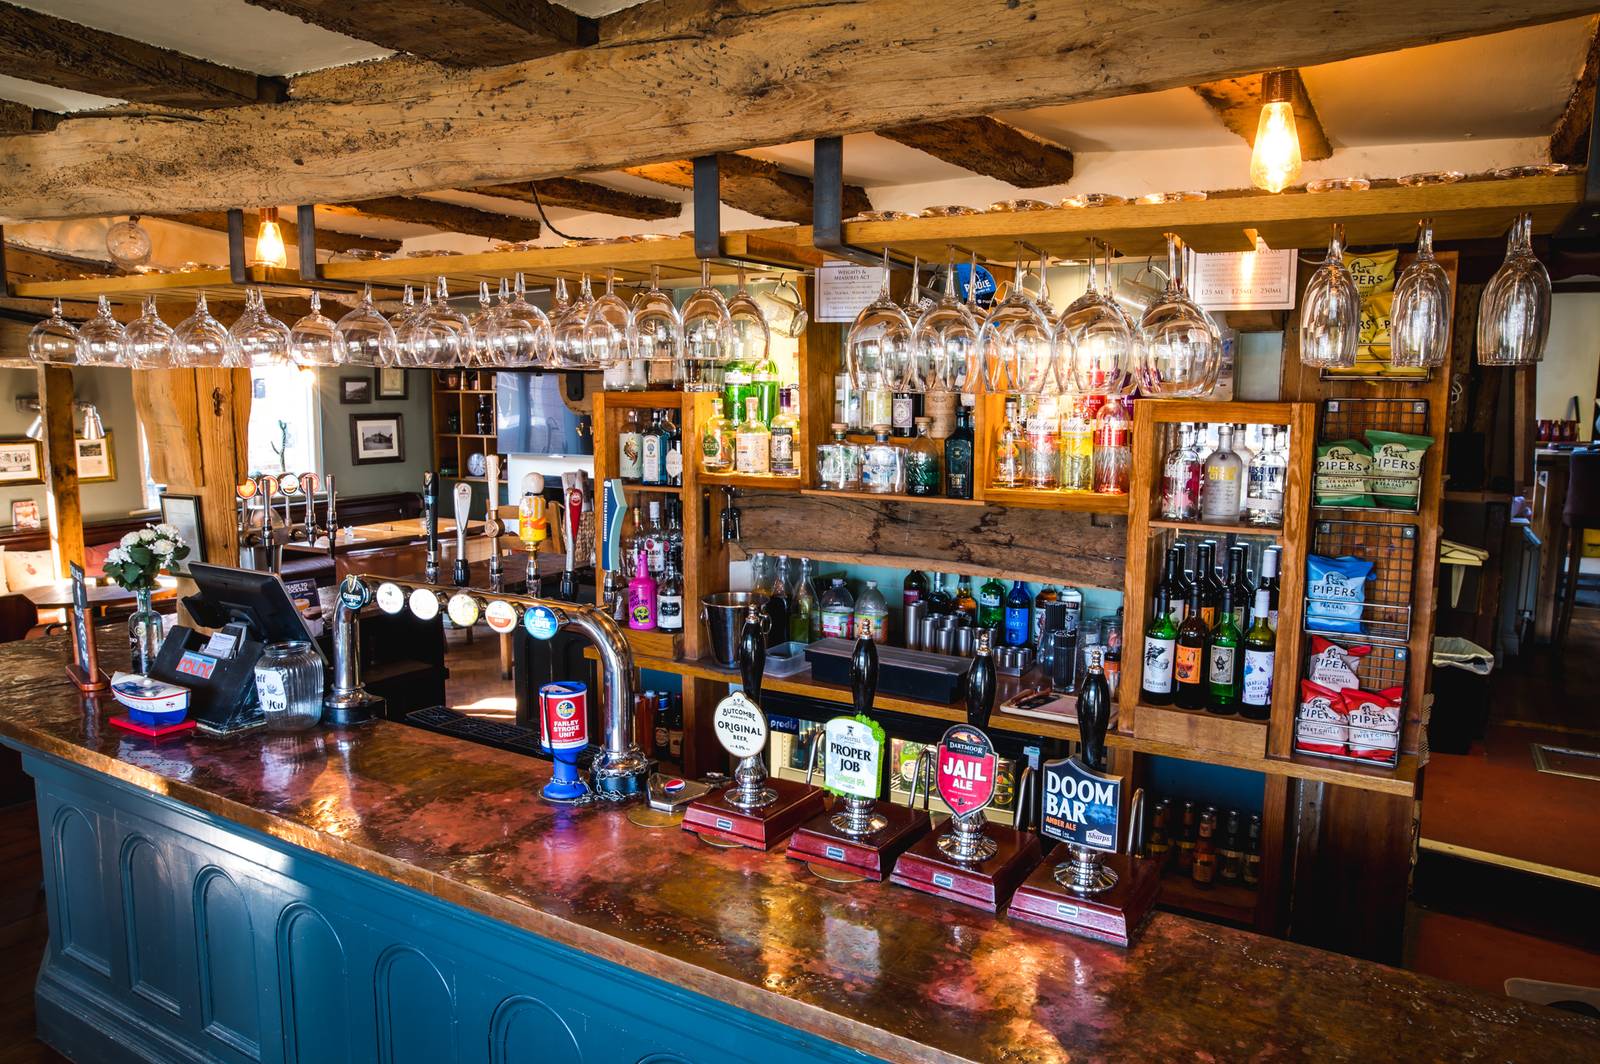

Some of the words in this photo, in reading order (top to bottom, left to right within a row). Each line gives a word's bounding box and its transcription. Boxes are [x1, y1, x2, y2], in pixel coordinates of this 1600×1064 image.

[1318, 460, 1362, 472] PIPERS
[1372, 456, 1416, 471] PIPERS
[1313, 584, 1356, 598] PIPERS
[1315, 657, 1348, 670] PIPER
[722, 708, 756, 722] BUTCOMBE
[553, 719, 579, 727] FARLEY
[553, 724, 580, 733] STROKE
[717, 720, 763, 736] ORIGINAL
[732, 734, 748, 743] BEER
[830, 742, 872, 762] PROPER
[949, 741, 983, 754] DARTMOOR
[839, 758, 861, 773] JOB
[942, 757, 987, 782] JAIL
[952, 778, 973, 791] ALE
[1046, 770, 1115, 807] DOOM
[1046, 791, 1088, 825] BAR
[1045, 815, 1065, 829] AMBER
[1065, 822, 1077, 832] ALE
